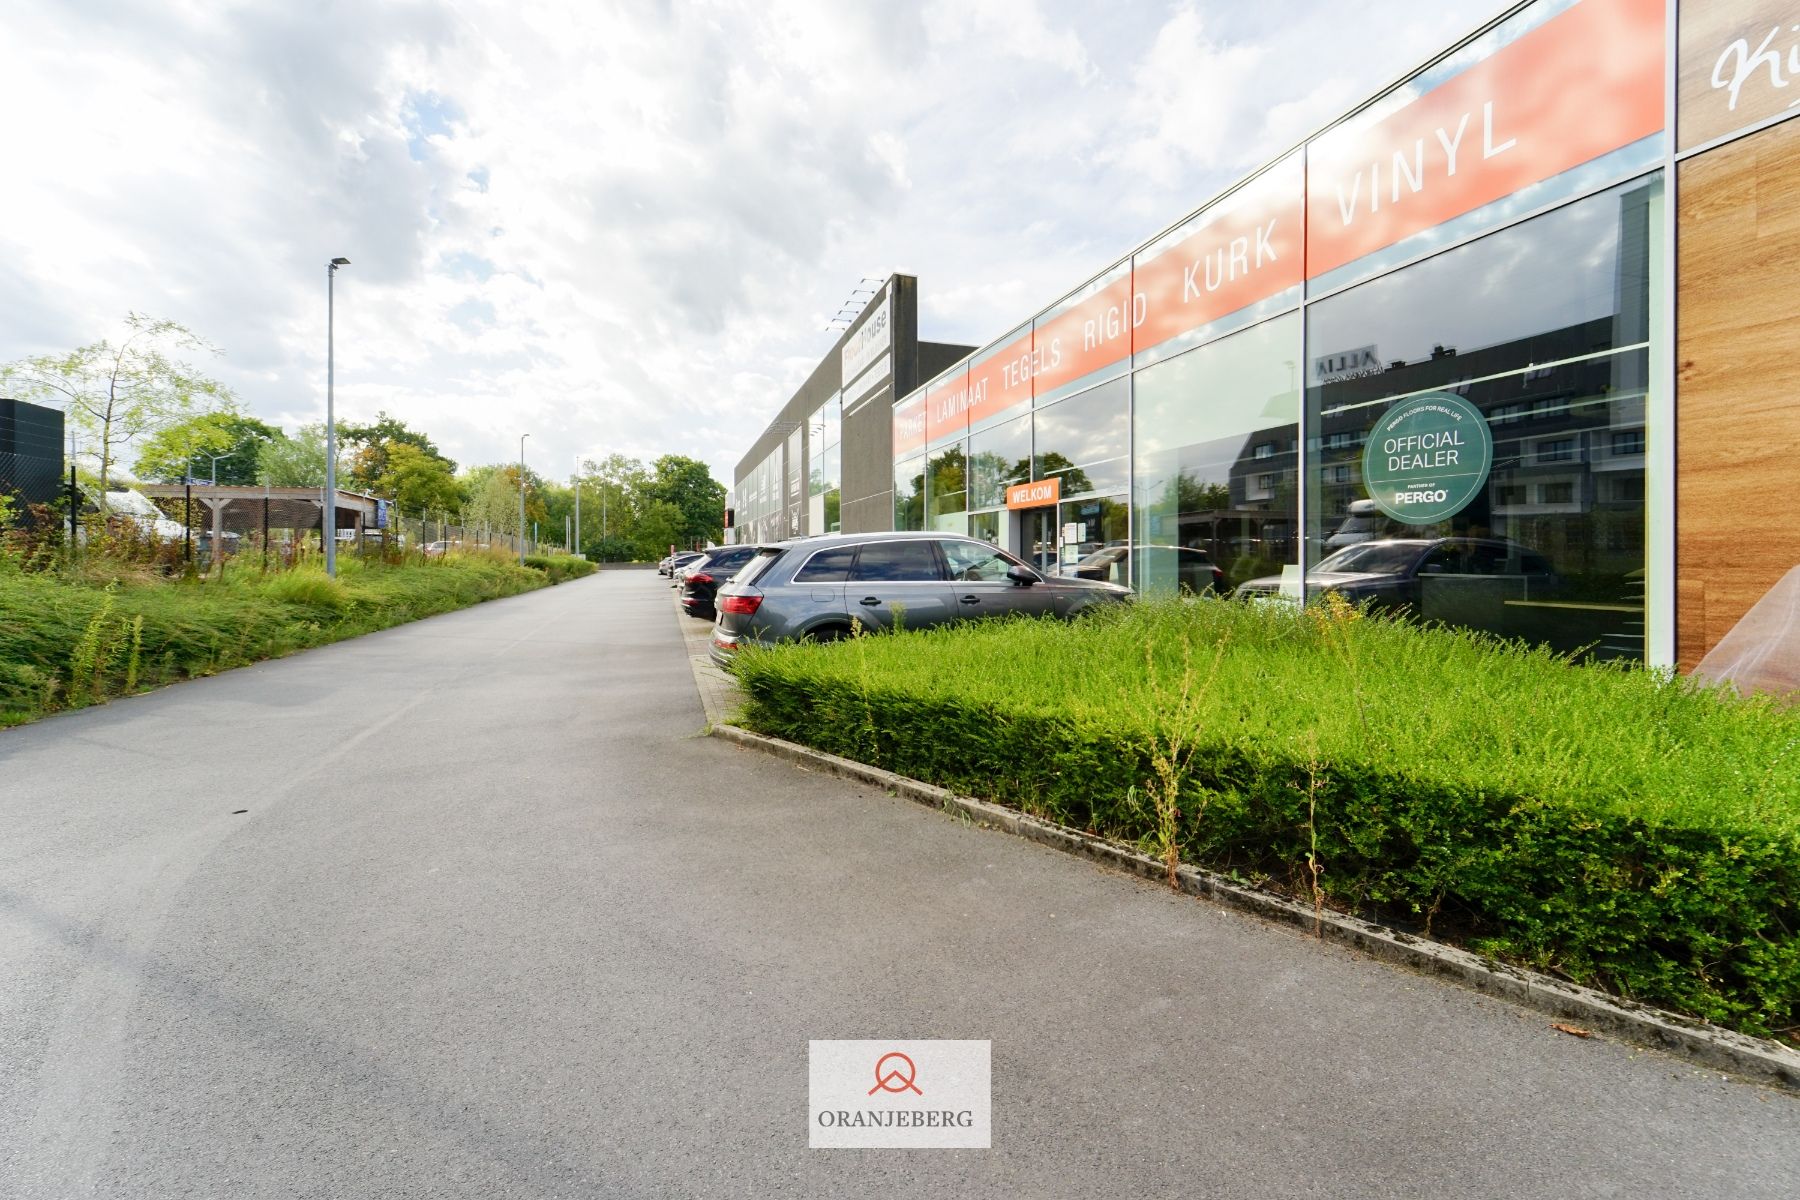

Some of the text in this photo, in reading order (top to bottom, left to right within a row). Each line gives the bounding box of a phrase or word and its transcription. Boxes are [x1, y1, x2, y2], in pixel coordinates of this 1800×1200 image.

[937, 377, 988, 424] LAMINAAT
[1003, 338, 1062, 391] TEGELS
[1084, 292, 1147, 353] RIGID
[1183, 218, 1279, 303] KURK
[1335, 101, 1517, 227] VINYL
[1387, 415, 1403, 432] PERGO
[1403, 405, 1425, 418] FLOORS
[1437, 405, 1450, 415] REAL
[1450, 411, 1462, 421] LIFE
[1384, 430, 1465, 454] OFFICIAL
[1388, 450, 1459, 472] DEALER
[1012, 485, 1052, 504] WELKOM
[1395, 489, 1447, 505] PERGO
